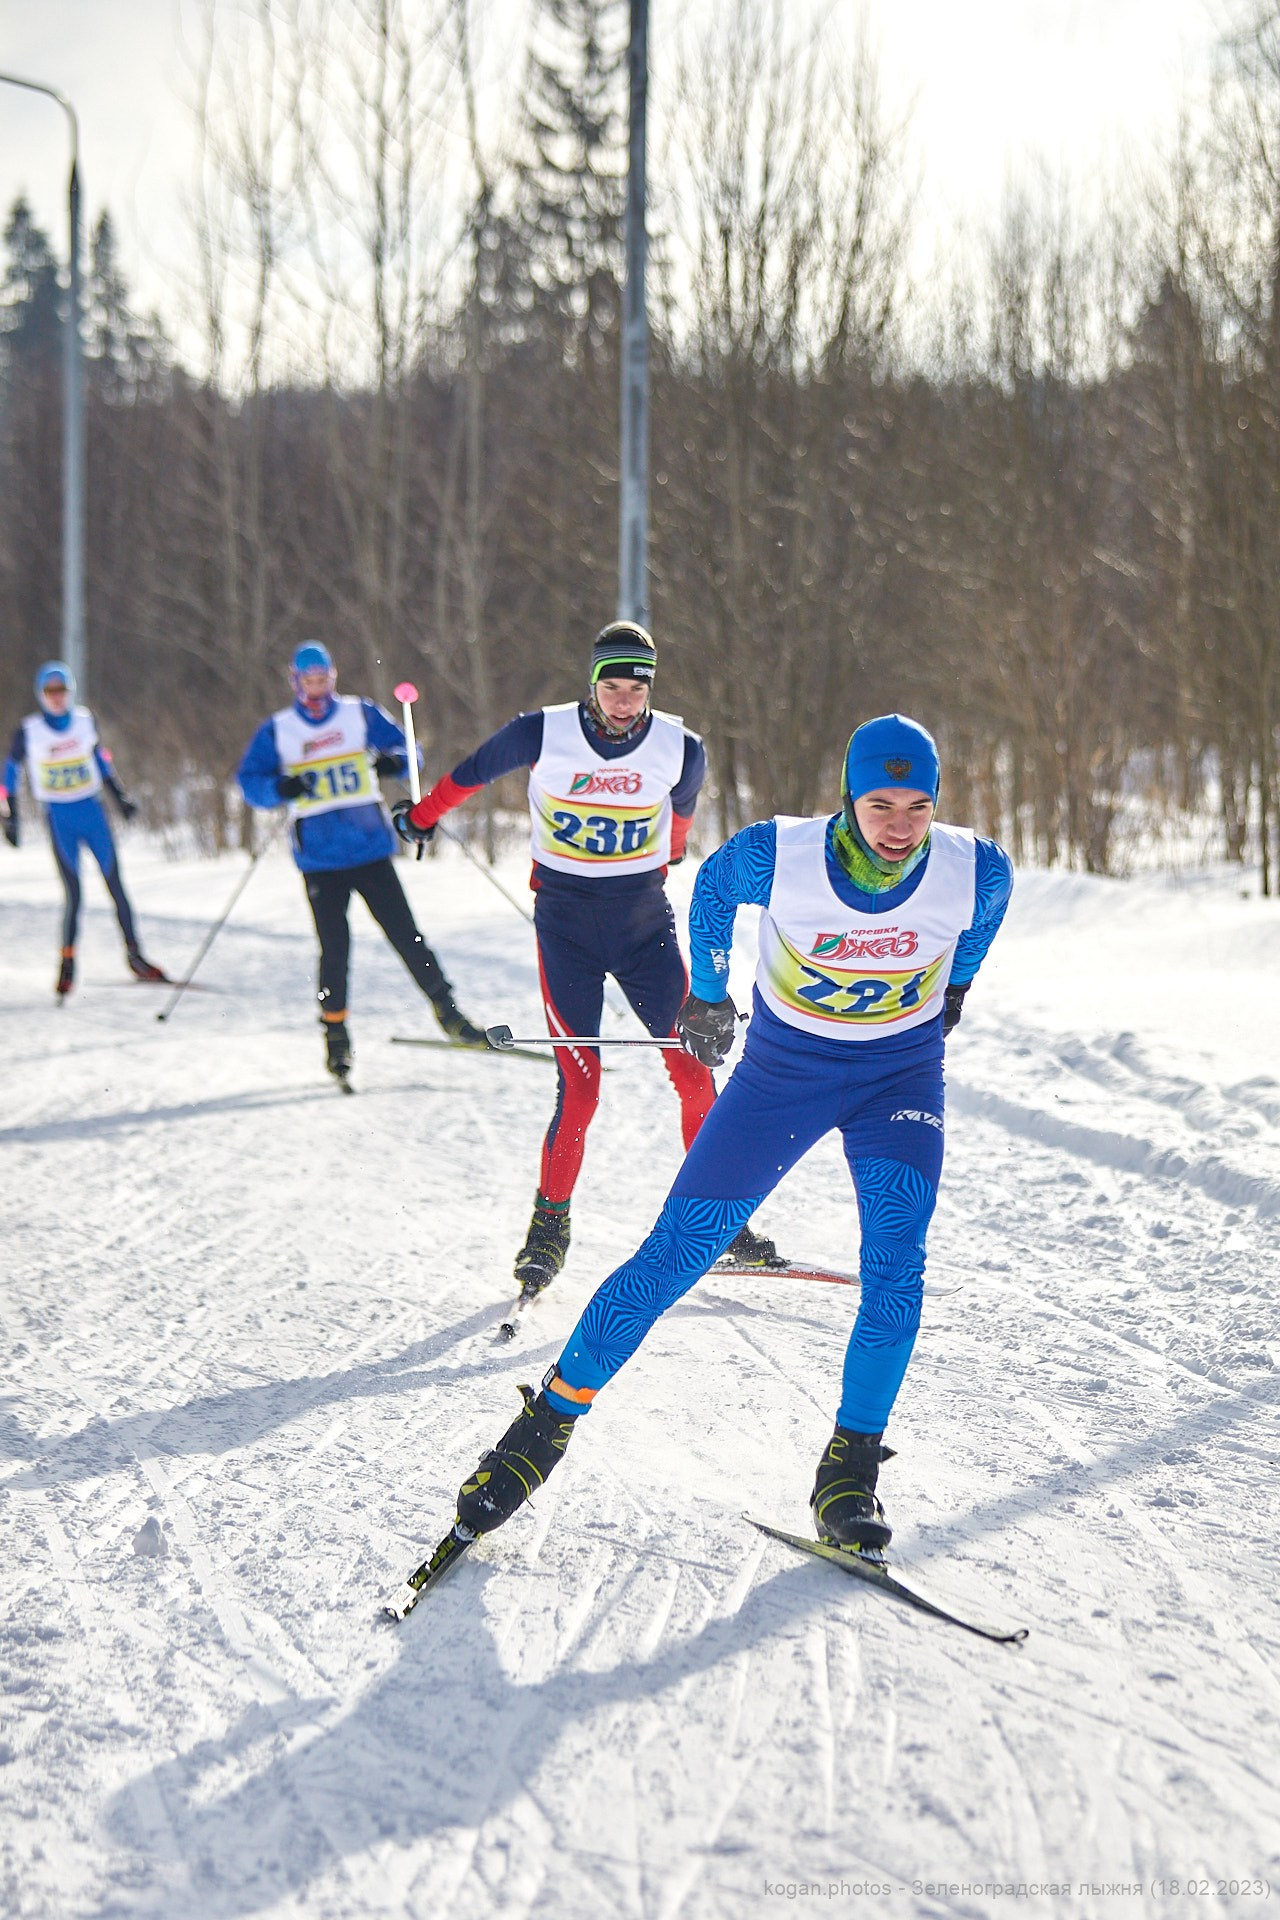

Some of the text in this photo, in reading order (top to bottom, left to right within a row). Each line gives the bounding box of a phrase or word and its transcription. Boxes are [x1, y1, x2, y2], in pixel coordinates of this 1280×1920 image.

[302, 763, 361, 799] 215
[552, 811, 652, 856] 236
[851, 926, 899, 936] орешки
